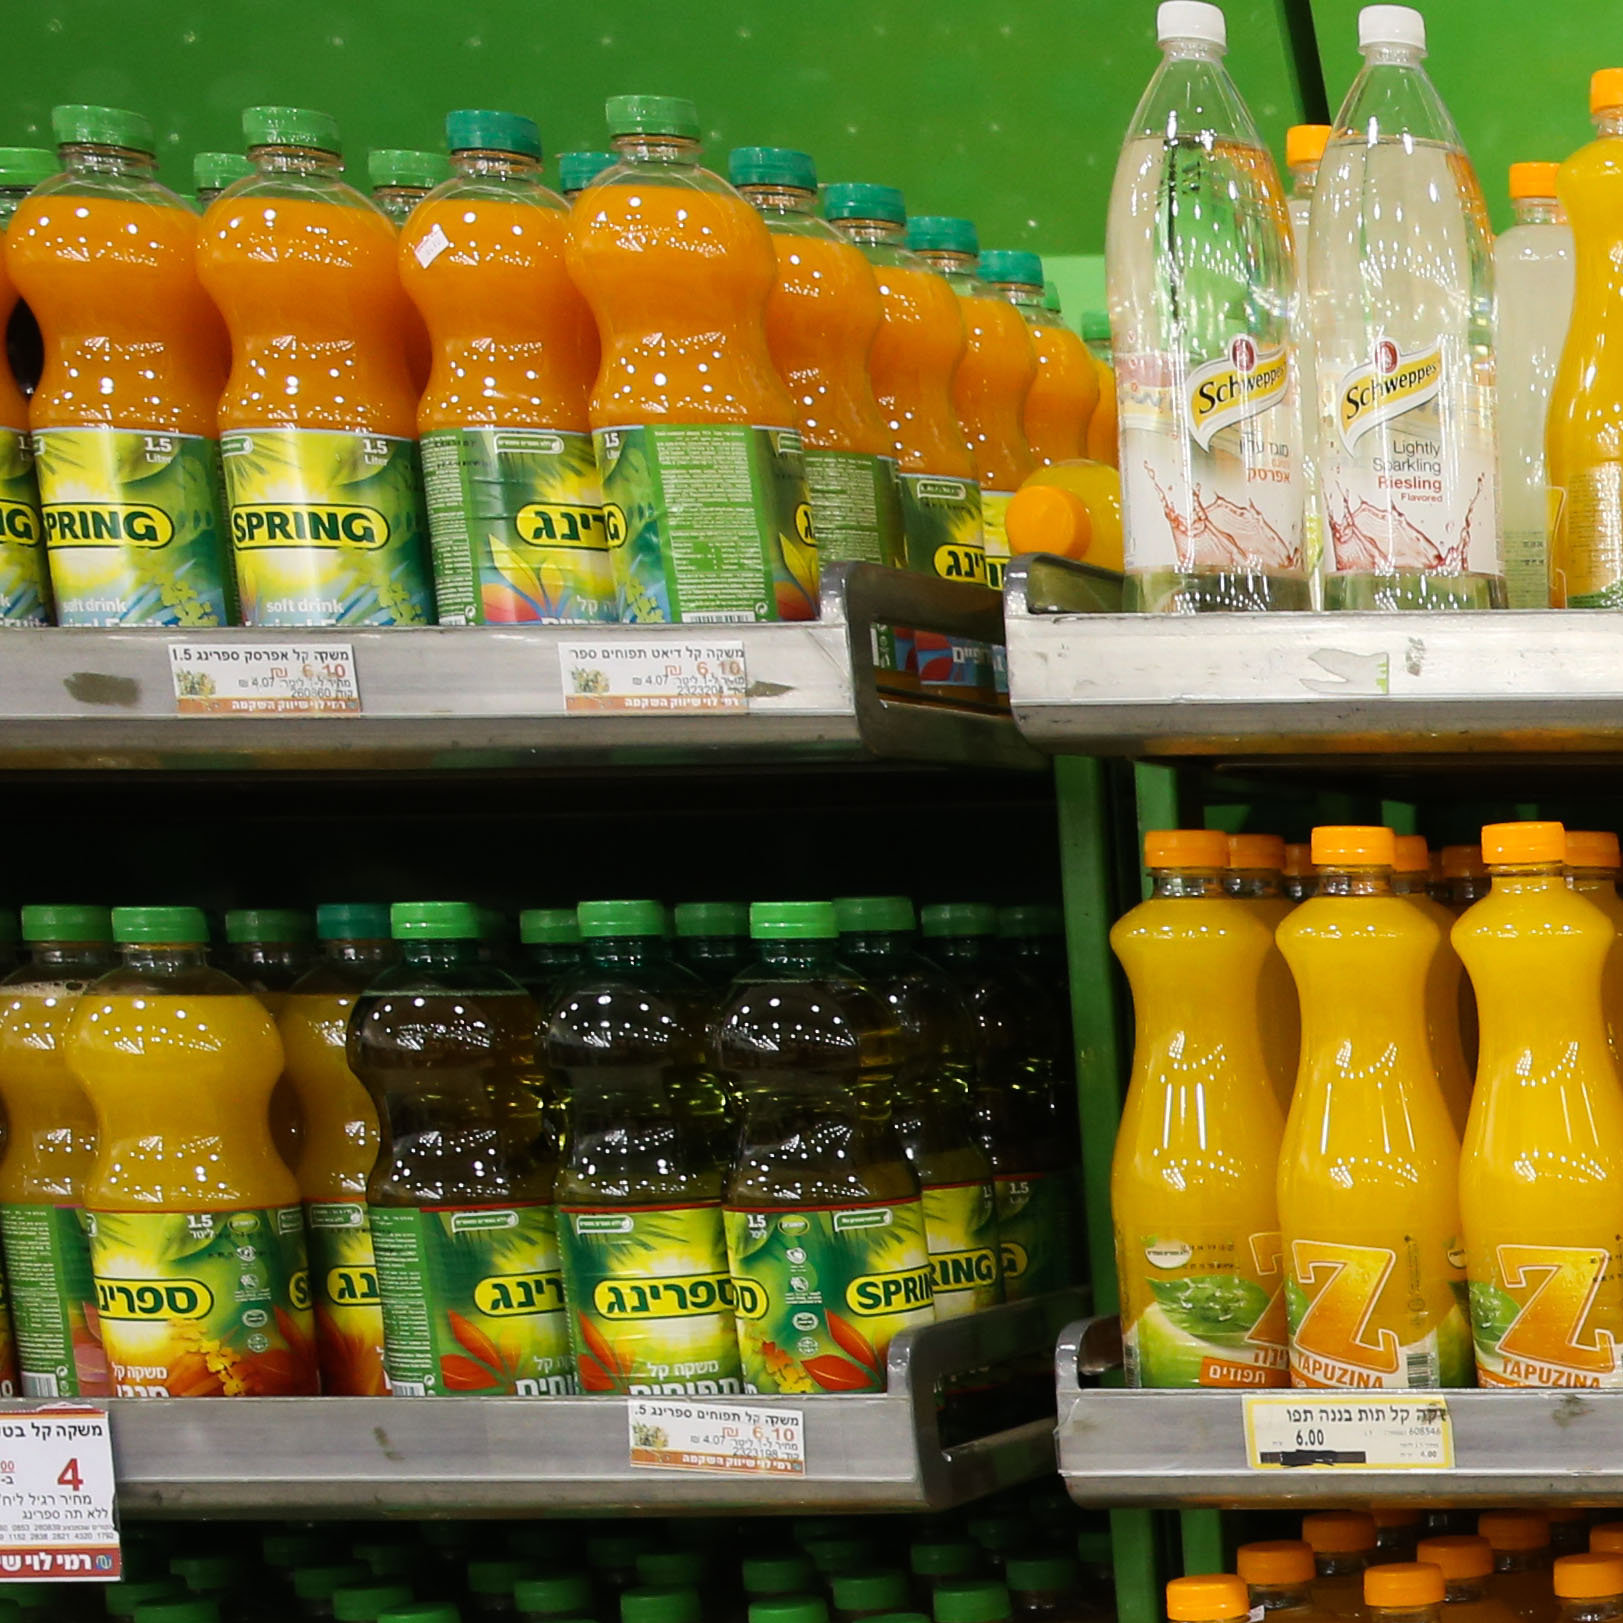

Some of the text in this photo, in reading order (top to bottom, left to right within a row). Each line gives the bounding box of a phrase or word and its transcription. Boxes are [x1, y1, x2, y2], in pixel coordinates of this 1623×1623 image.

[1346, 362, 1439, 420] Schweppes
[144, 436, 172, 452] 1.5
[363, 439, 388, 455] 1.5
[1393, 439, 1441, 458] Lightly
[1372, 457, 1443, 475] Sparkling
[1377, 475, 1443, 490] Riesling
[1400, 493, 1444, 503] Flavored
[233, 510, 375, 543] SPRING
[266, 597, 344, 613] soft drink
[245, 650, 289, 664] אפרסק
[1287, 1406, 1409, 1422] קל תות בננה תפו
[31, 1423, 103, 1442] משקה קל
[1296, 1430, 1324, 1446] 6.00
[57, 1458, 84, 1491] 4
[31, 1494, 92, 1506] מחיר רגיל
[22, 1510, 59, 1521] ספרינג
[25, 1552, 92, 1570] רמי לוי
